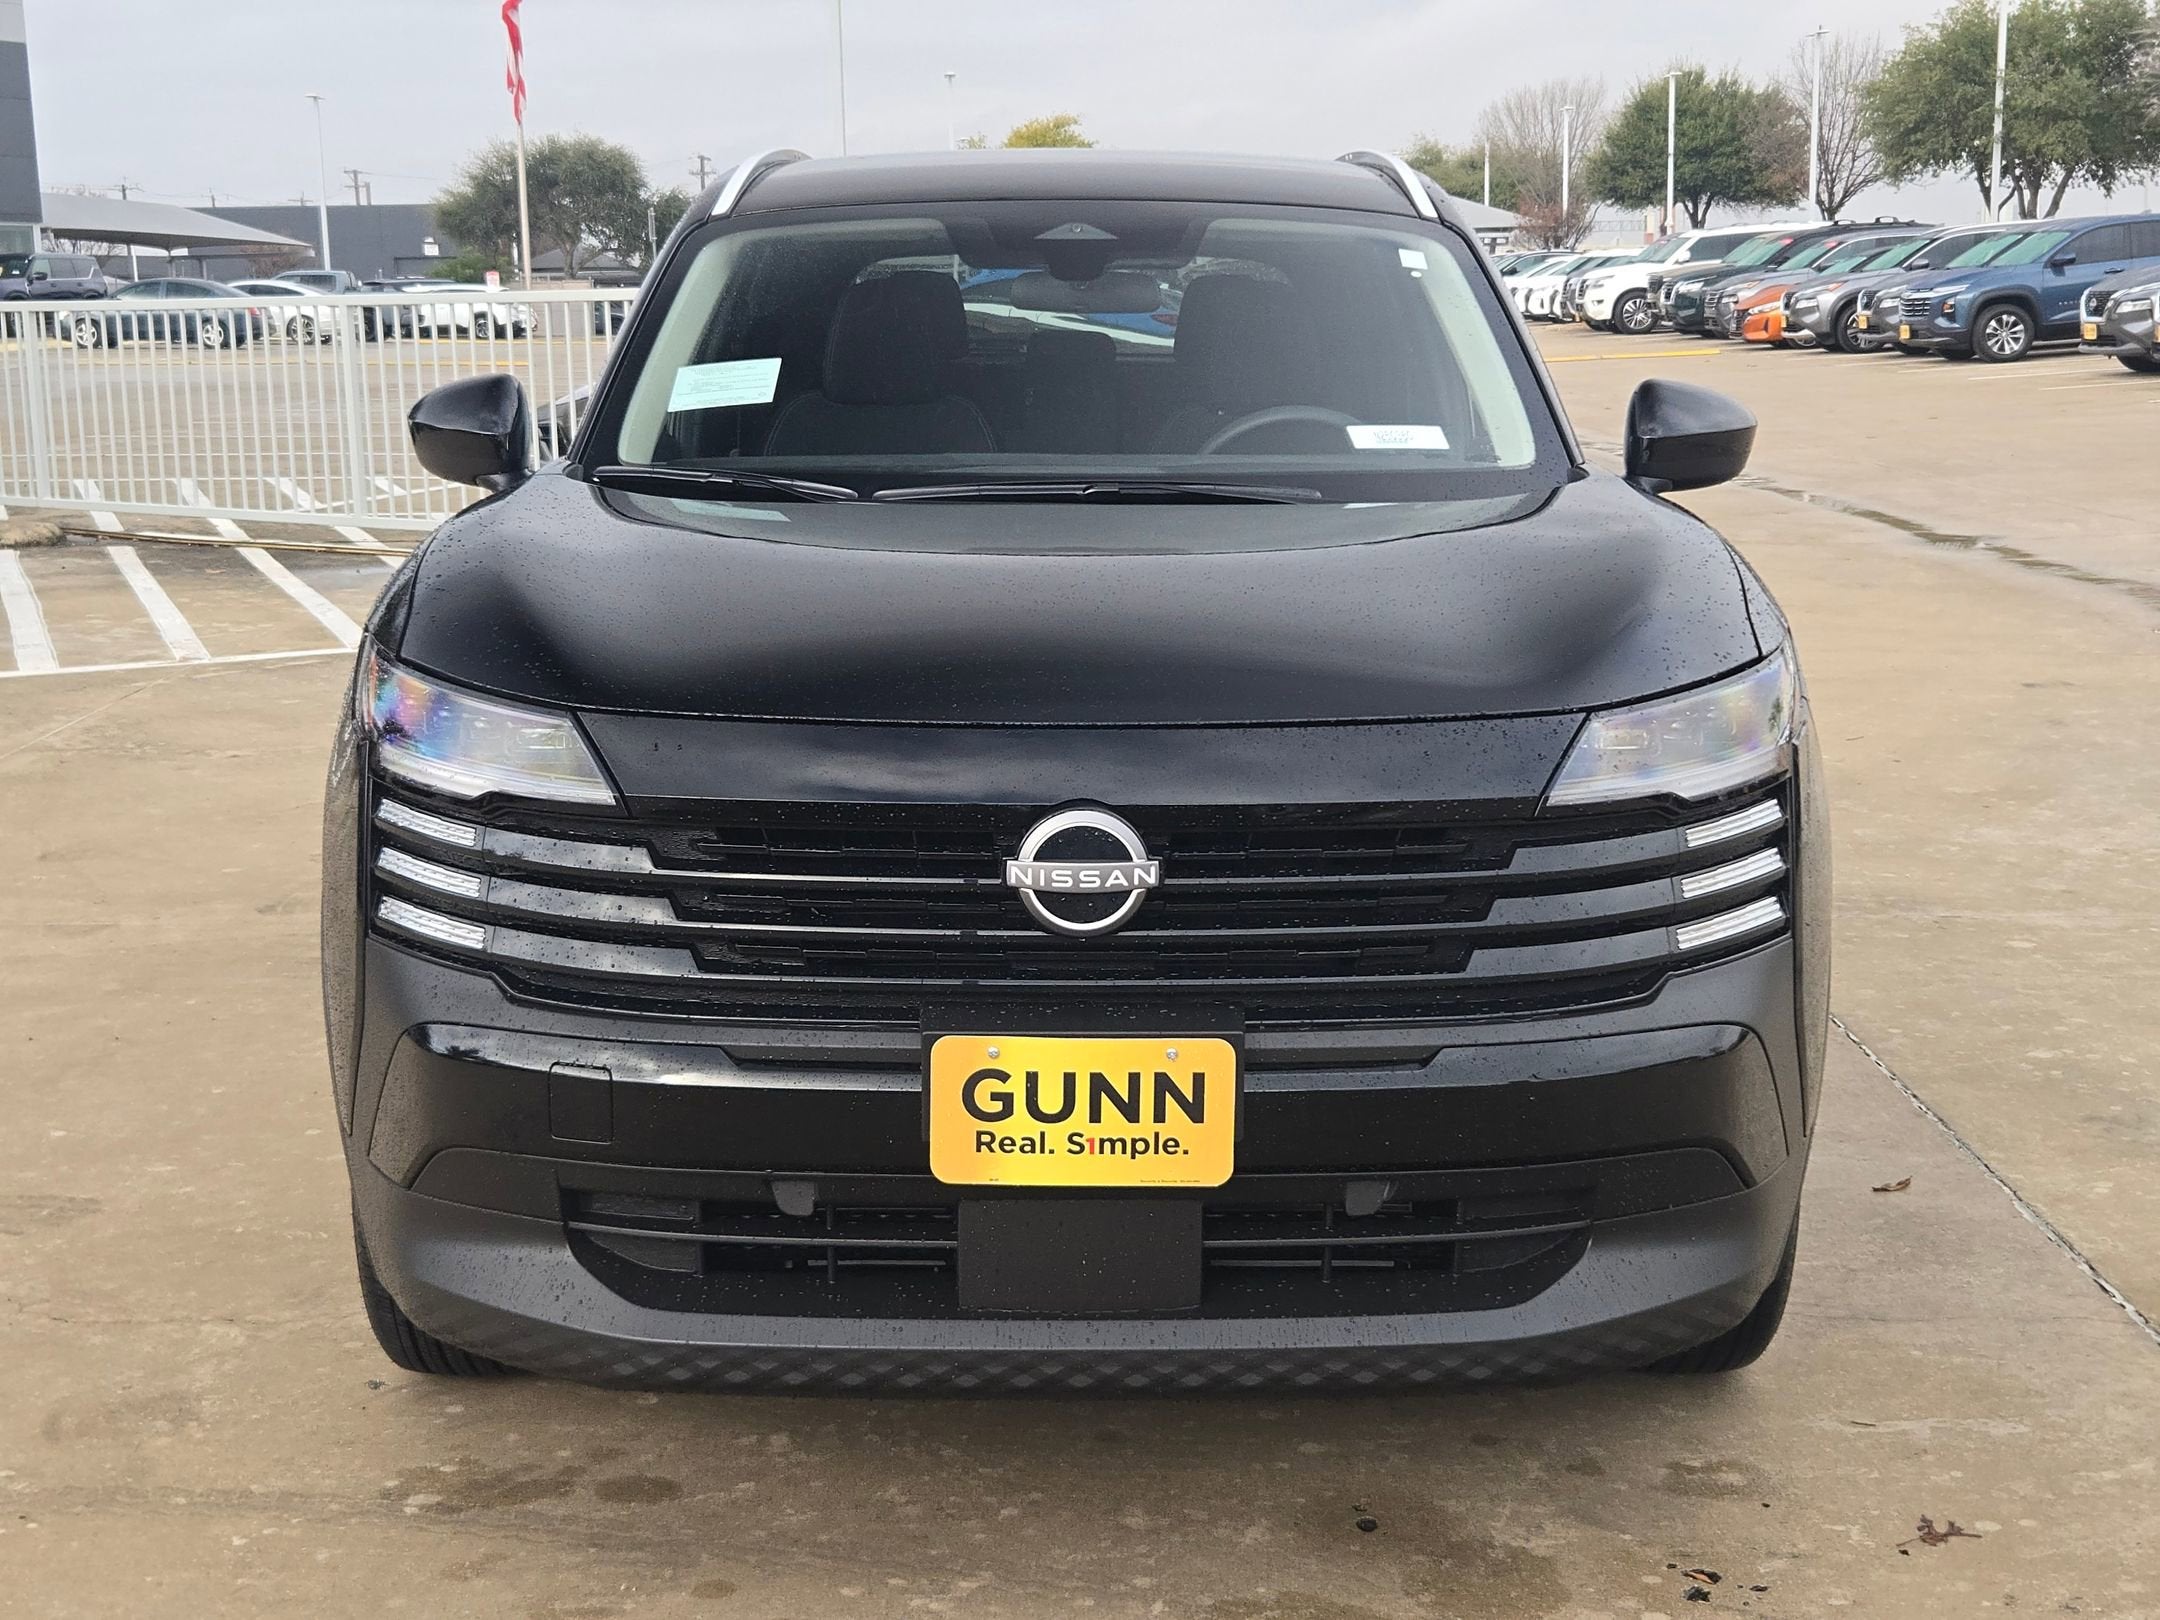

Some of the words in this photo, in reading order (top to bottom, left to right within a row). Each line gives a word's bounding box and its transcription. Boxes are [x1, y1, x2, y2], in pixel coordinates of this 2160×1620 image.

[1010, 865, 1156, 888] NISSAN
[961, 1068, 1206, 1124] GUNN
[975, 1130, 1055, 1155] Real.
